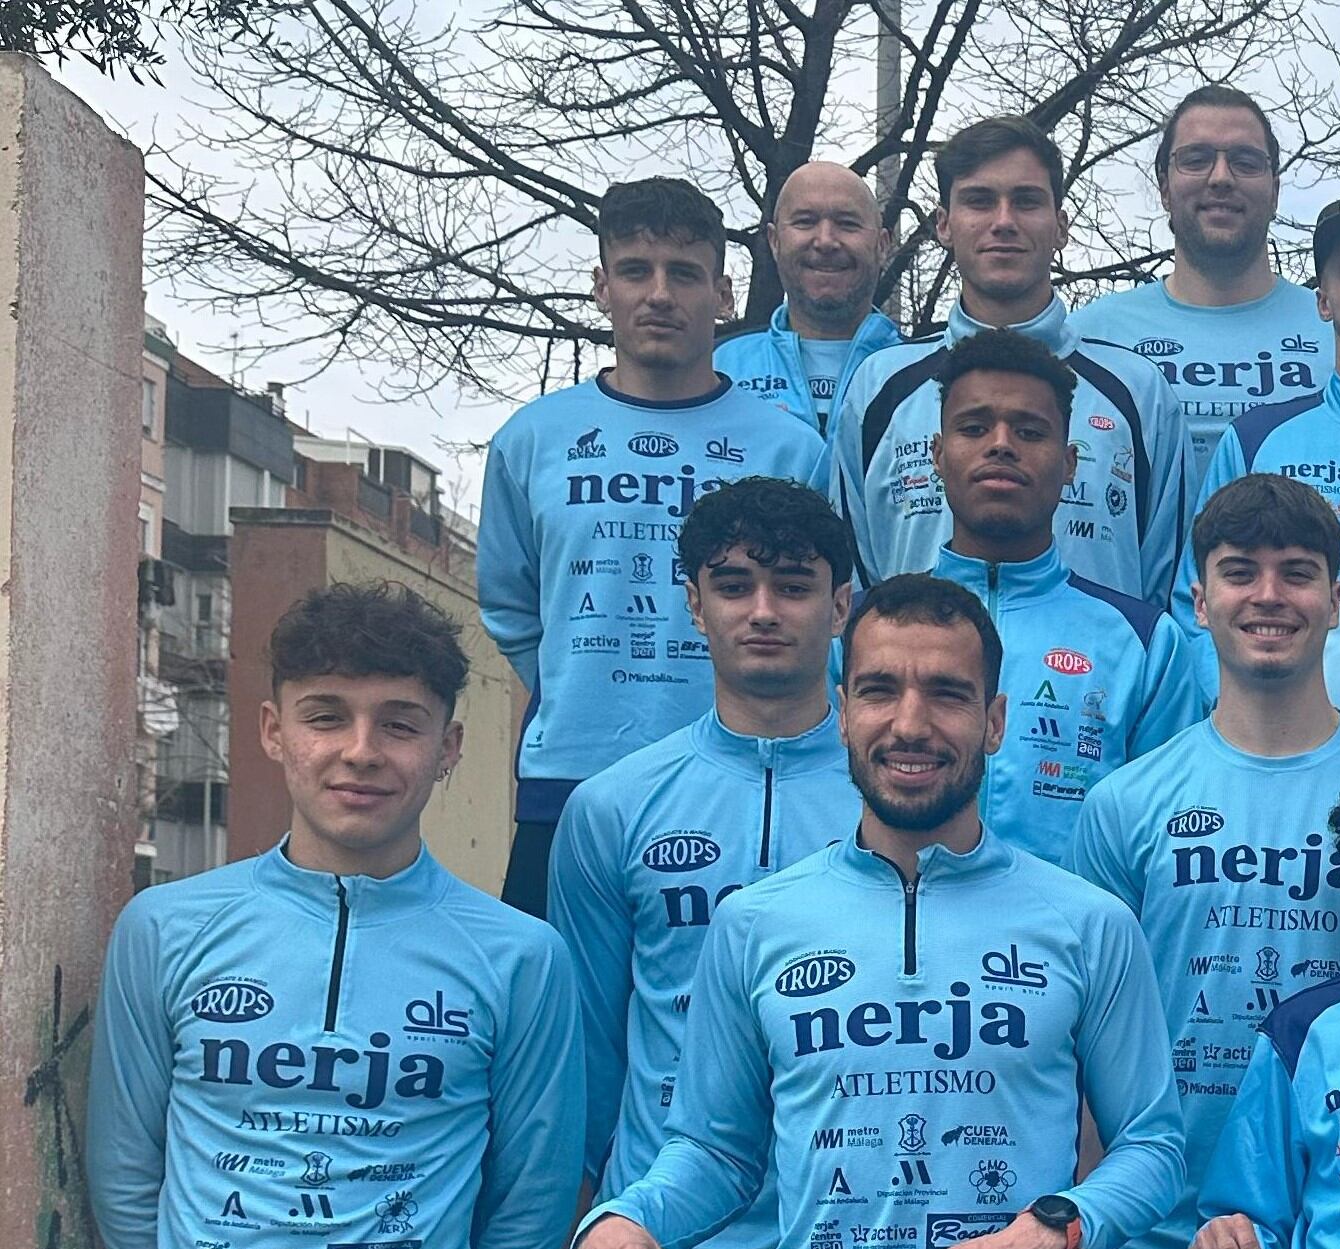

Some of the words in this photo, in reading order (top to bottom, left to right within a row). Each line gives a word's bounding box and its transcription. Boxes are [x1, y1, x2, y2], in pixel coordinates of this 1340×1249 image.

[1135, 340, 1181, 355] TROPS
[1281, 335, 1319, 354] als
[737, 374, 789, 392] erja
[810, 379, 838, 396] ROP
[1183, 401, 1265, 417] TLETIS
[630, 435, 678, 456] TROPS
[705, 437, 745, 463] als
[592, 521, 683, 542] ATLETIS
[583, 634, 621, 648] activa
[1046, 652, 1091, 673] TROPS
[1169, 810, 1223, 835] TROPS
[646, 837, 718, 869] TROPS
[1204, 906, 1339, 933] ATLETISMO
[779, 958, 851, 993] TROPS
[981, 944, 1049, 989] als
[194, 991, 270, 1016] TROPS
[402, 990, 471, 1038] als
[789, 981, 1030, 1061] nerja
[1223, 1045, 1252, 1061] acti
[199, 1031, 445, 1109] nerja
[831, 1070, 997, 1100] ATLETISMO
[236, 1111, 405, 1138] ATLETISMO
[847, 1126, 880, 1136] metro
[963, 1125, 1009, 1138] CUEVA
[253, 1157, 286, 1168] metro
[373, 1163, 417, 1174] CUEVA
[978, 1160, 1009, 1172] CMD
[870, 1224, 918, 1241] activa
